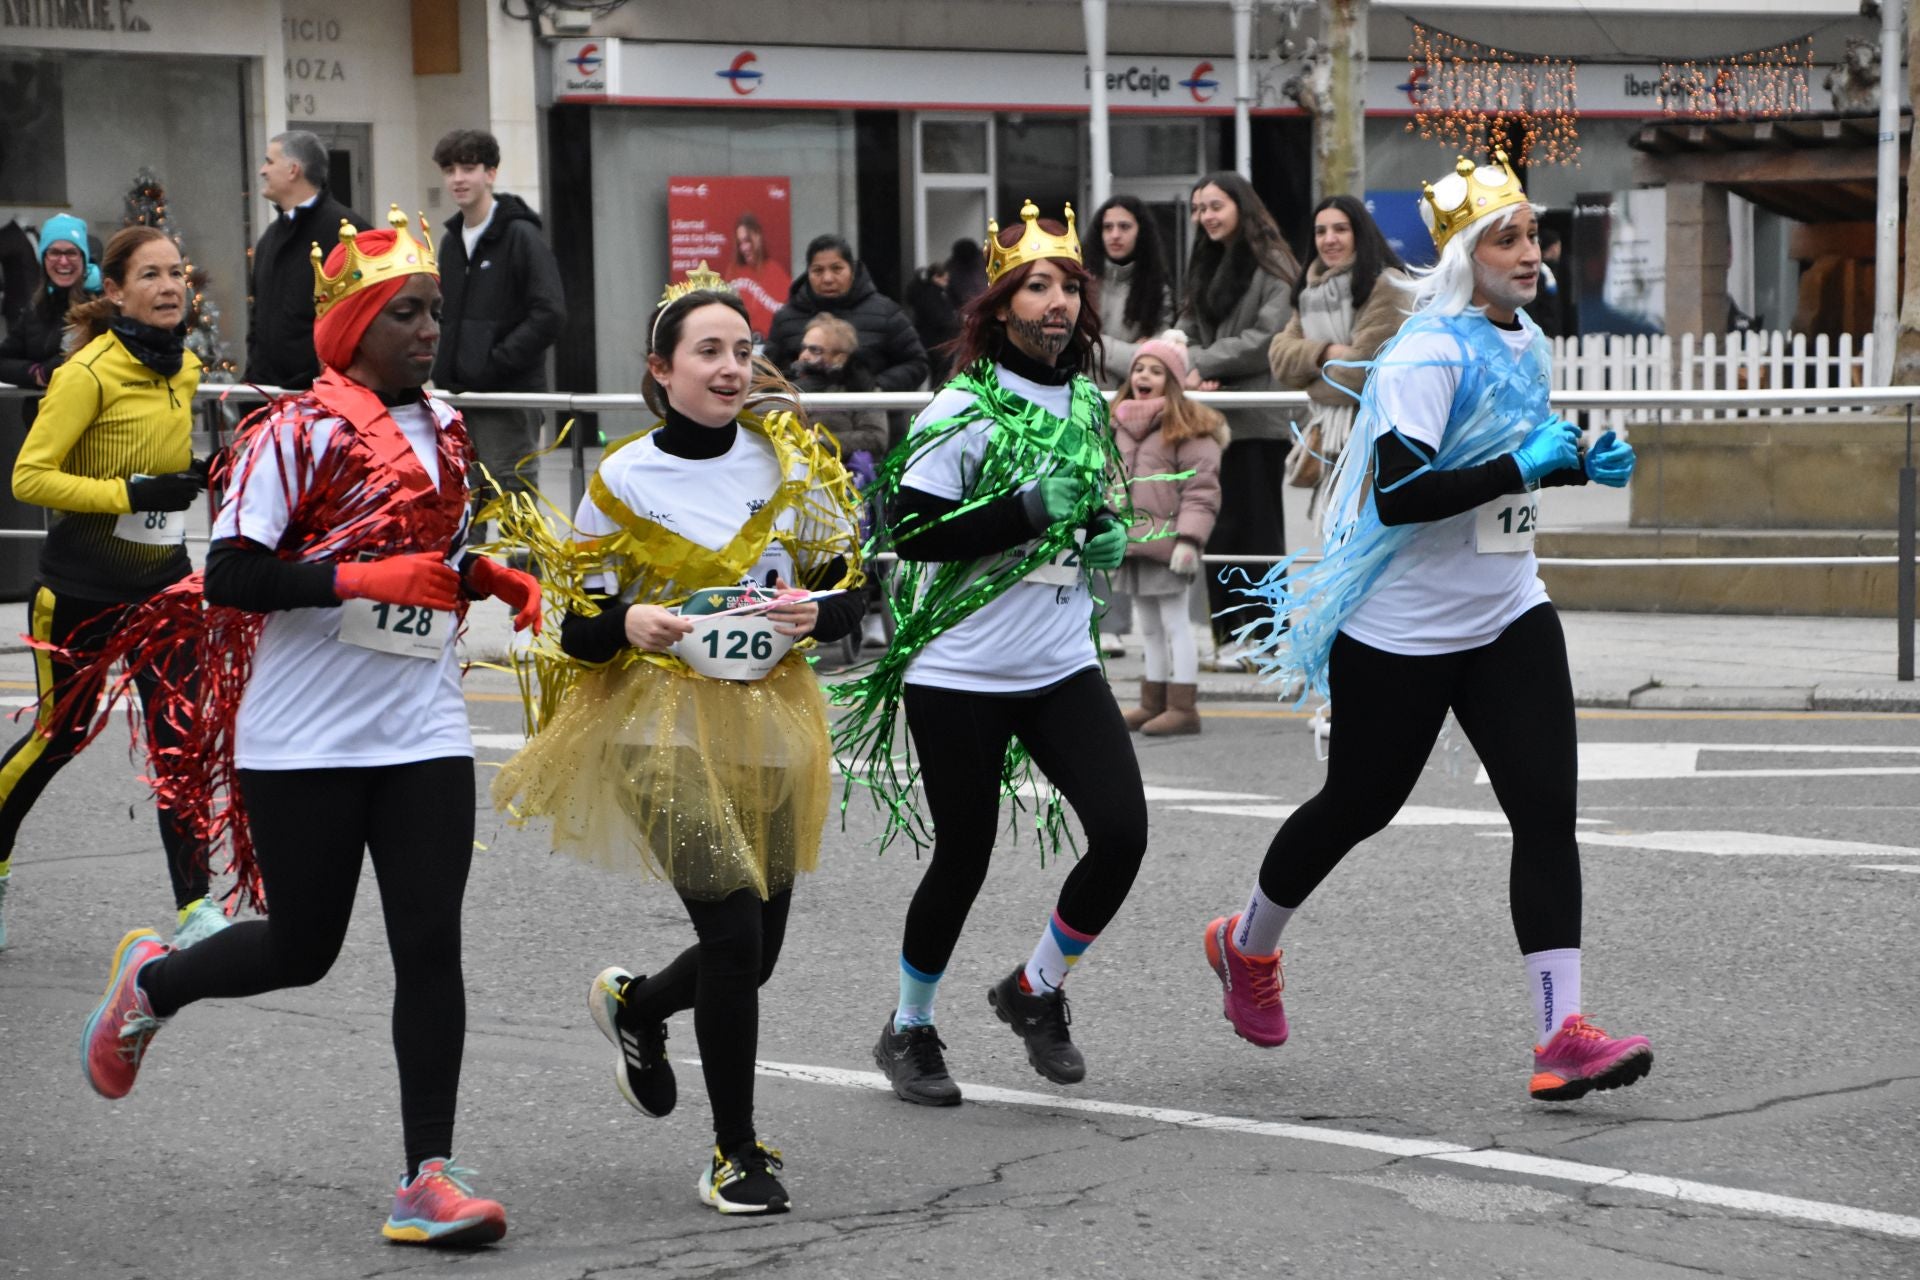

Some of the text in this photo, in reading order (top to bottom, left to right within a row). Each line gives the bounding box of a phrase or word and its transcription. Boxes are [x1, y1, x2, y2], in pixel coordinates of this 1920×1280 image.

[1084, 65, 1171, 98] ierCaja
[304, 94, 315, 115] 3
[371, 602, 434, 637] 128
[702, 629, 773, 660] 126
[1540, 970, 1554, 1034] SALOMON
